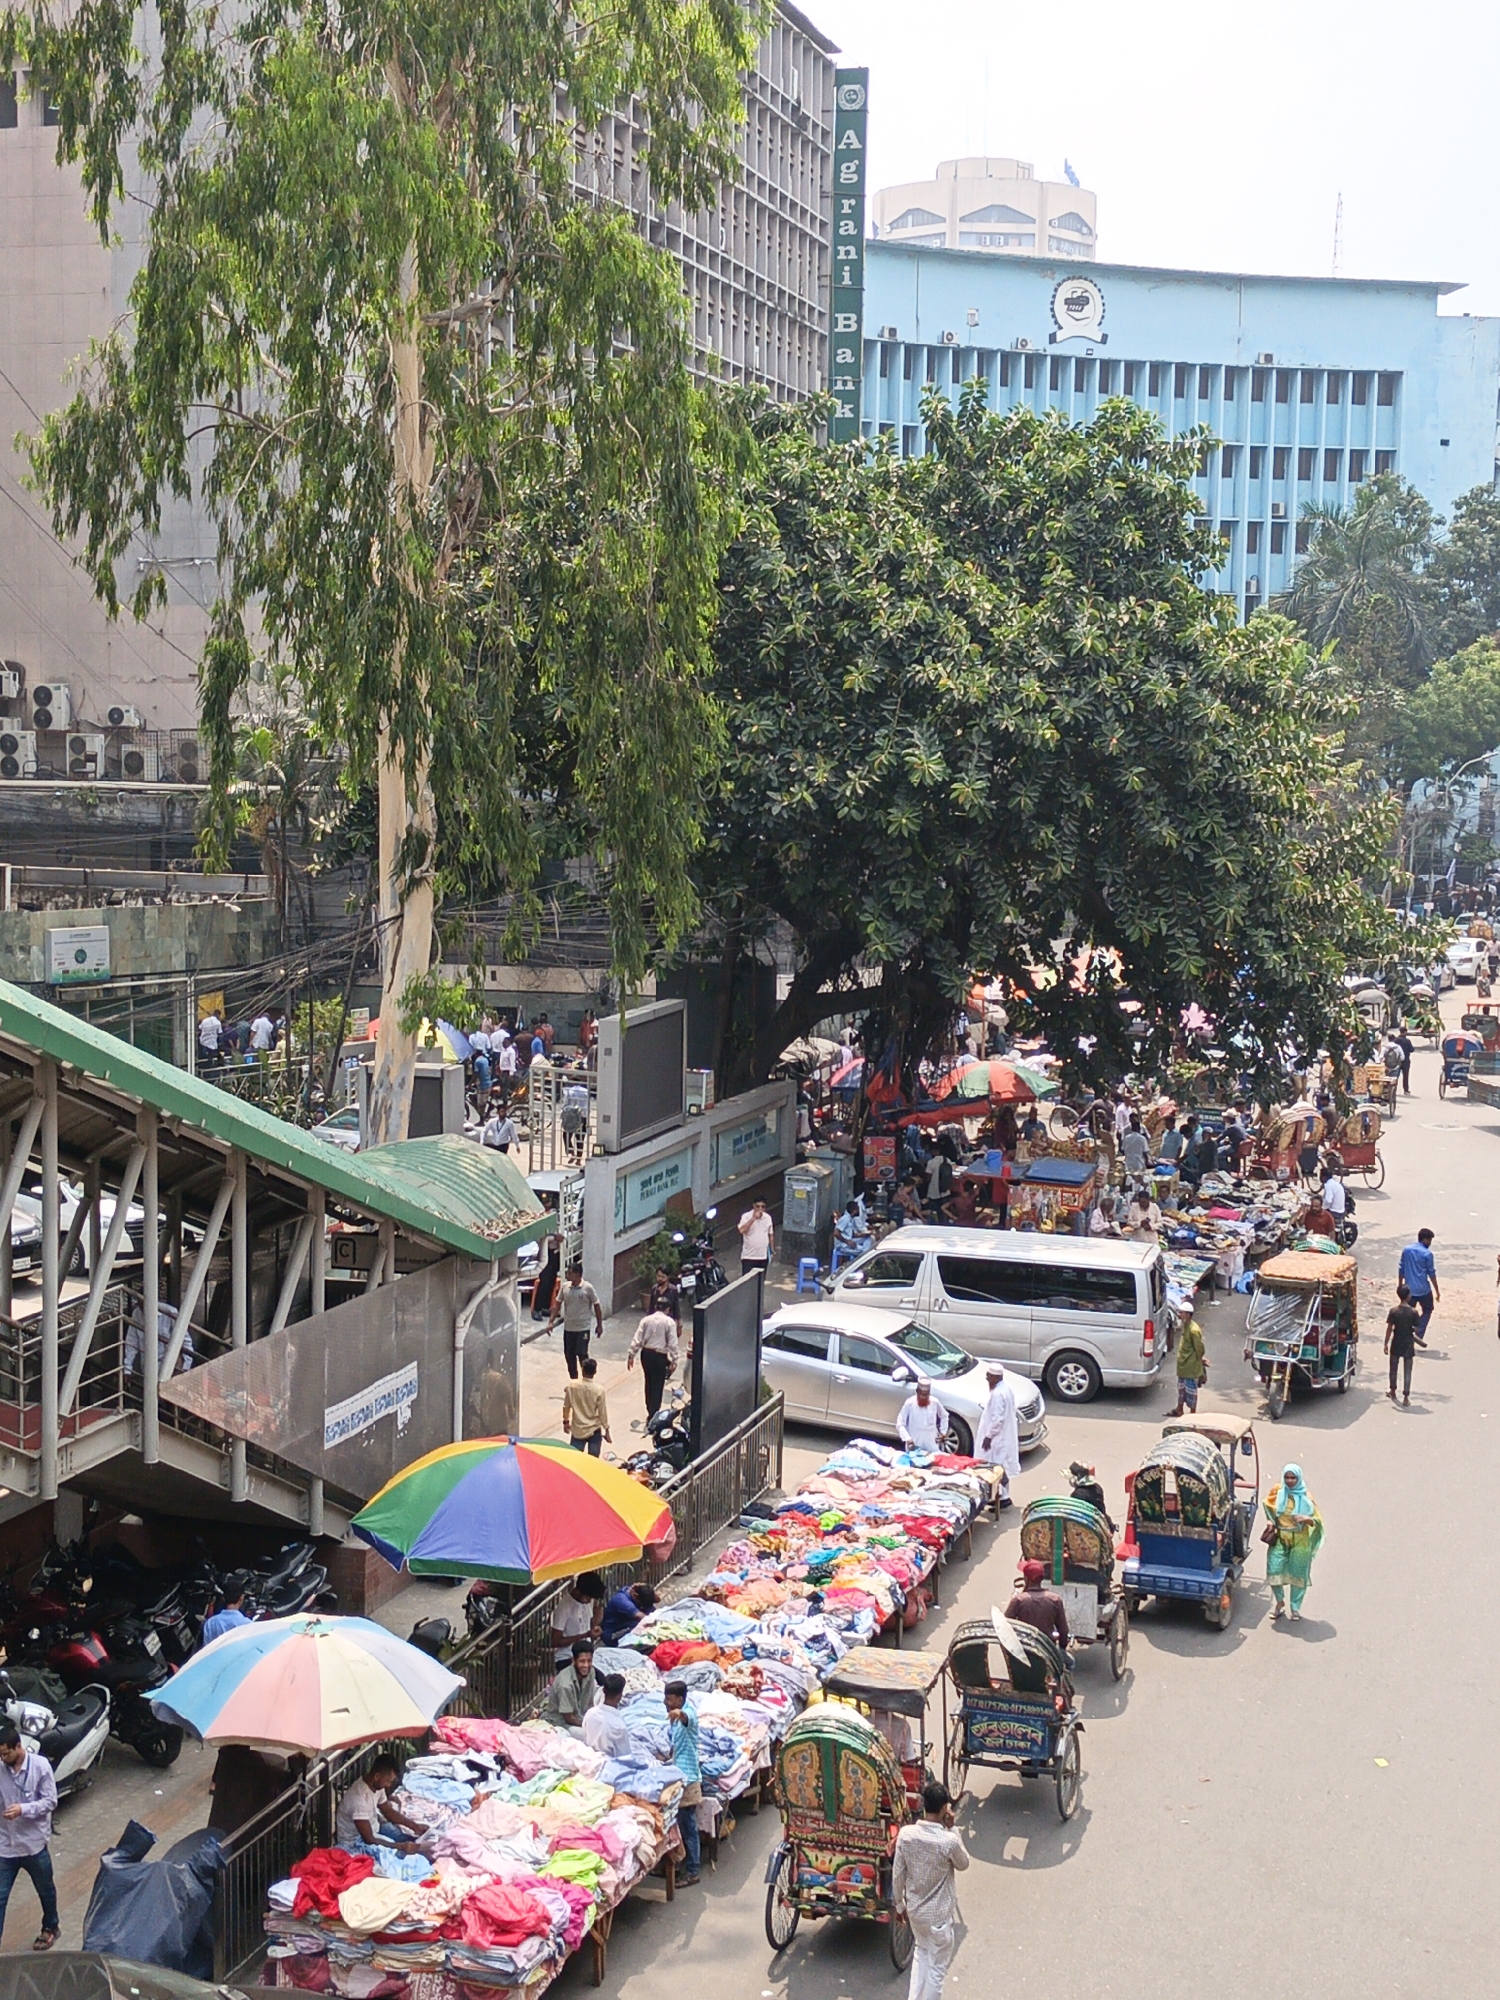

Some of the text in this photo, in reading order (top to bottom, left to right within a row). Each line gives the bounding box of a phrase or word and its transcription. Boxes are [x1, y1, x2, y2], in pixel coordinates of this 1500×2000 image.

[837, 129, 862, 285] Agrani
[834, 312, 858, 418] Bank
[657, 1180, 669, 1194] BANK
[669, 1176, 680, 1188] PLC
